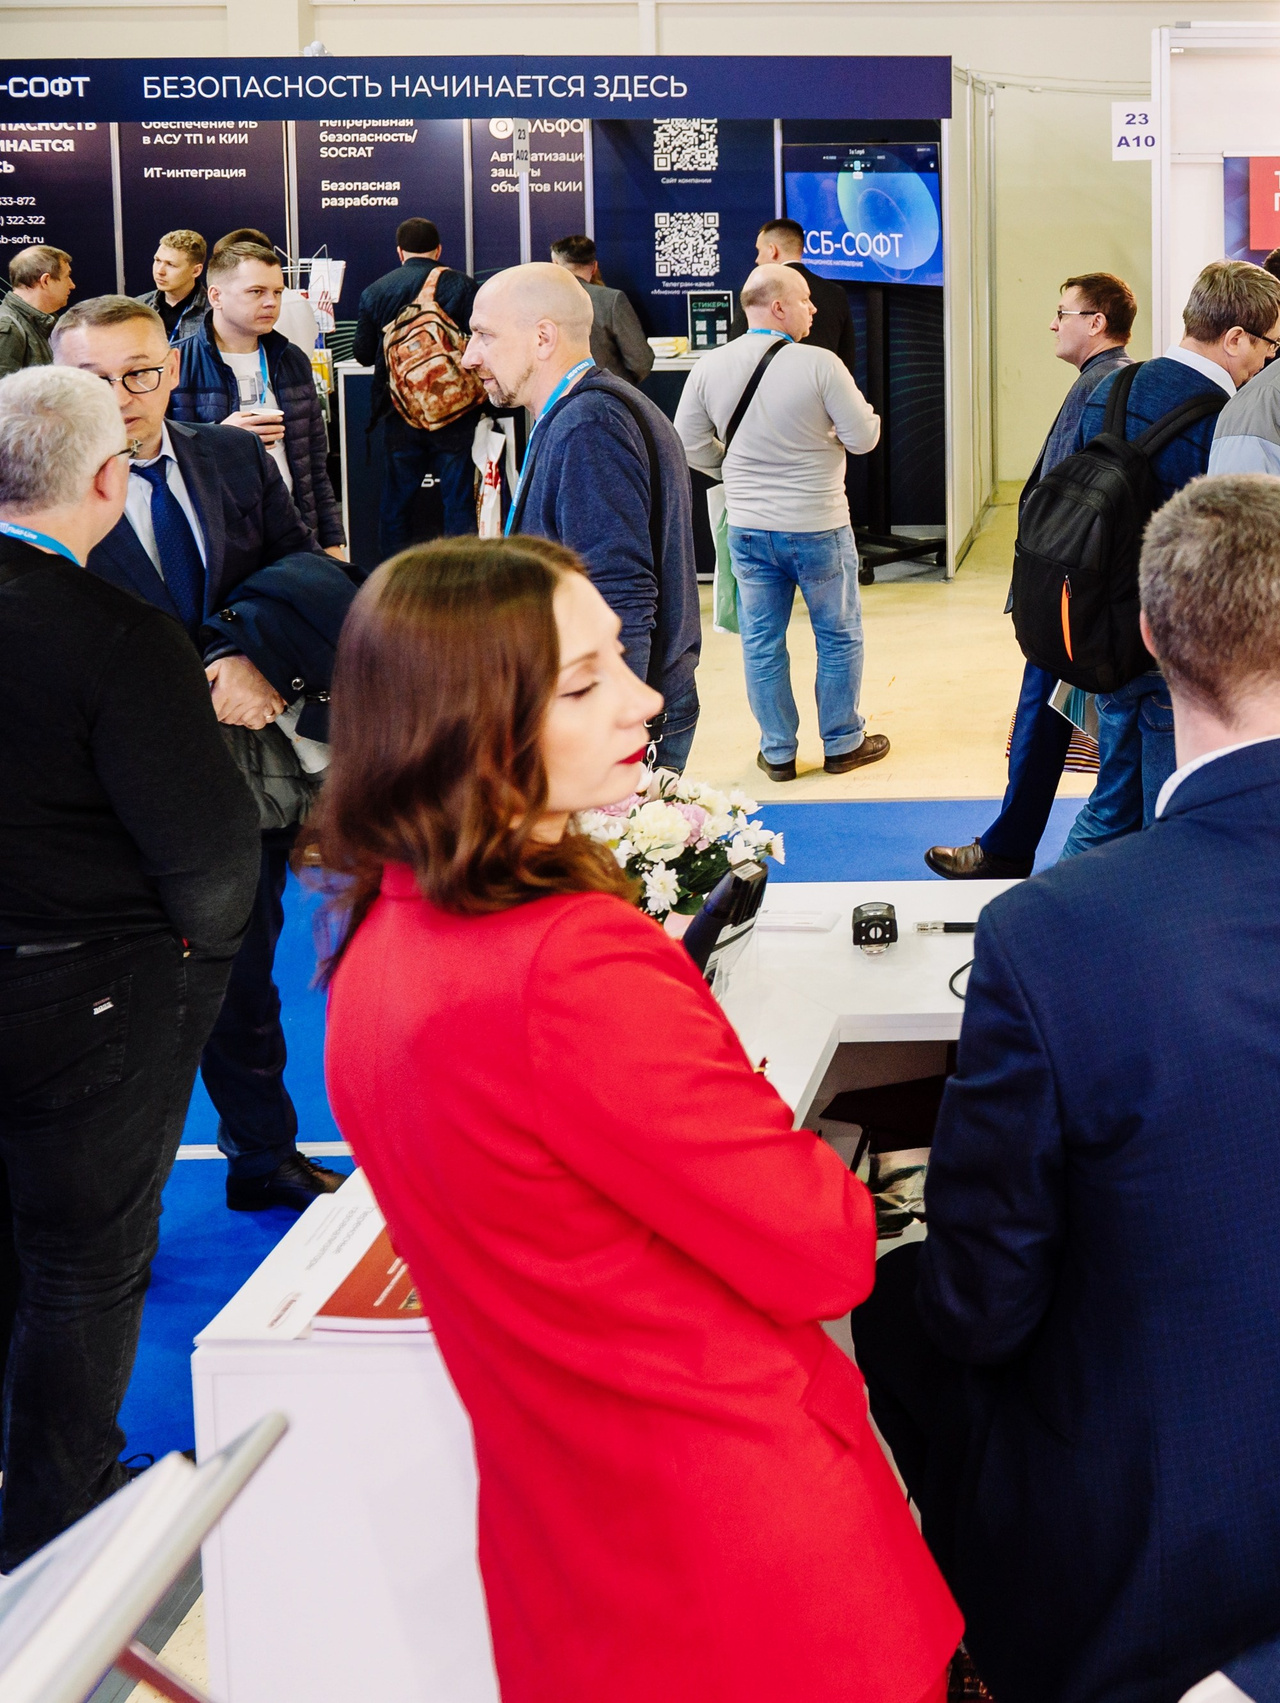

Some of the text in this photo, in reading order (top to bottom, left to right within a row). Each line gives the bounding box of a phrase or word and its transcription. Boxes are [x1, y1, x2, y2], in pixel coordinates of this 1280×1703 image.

[143, 74, 688, 102] БЕЗОПАСНОСТЬ НАЧИНАЕТСЯ ЗДЕСЬ
[1125, 113, 1149, 125] 23
[142, 133, 249, 144] в АСУ ТП и КИИ
[319, 129, 418, 143] безопасность/
[517, 129, 526, 140] 23
[1116, 135, 1156, 147] A10
[319, 147, 374, 158] SOCRAT
[143, 167, 247, 180] ИТ-интеграция
[321, 180, 401, 191] Безопасная
[554, 181, 583, 192] КИИ
[321, 194, 399, 209] разработка
[6, 216, 45, 225] 322-322
[0, 235, 44, 244] b-soft.ru
